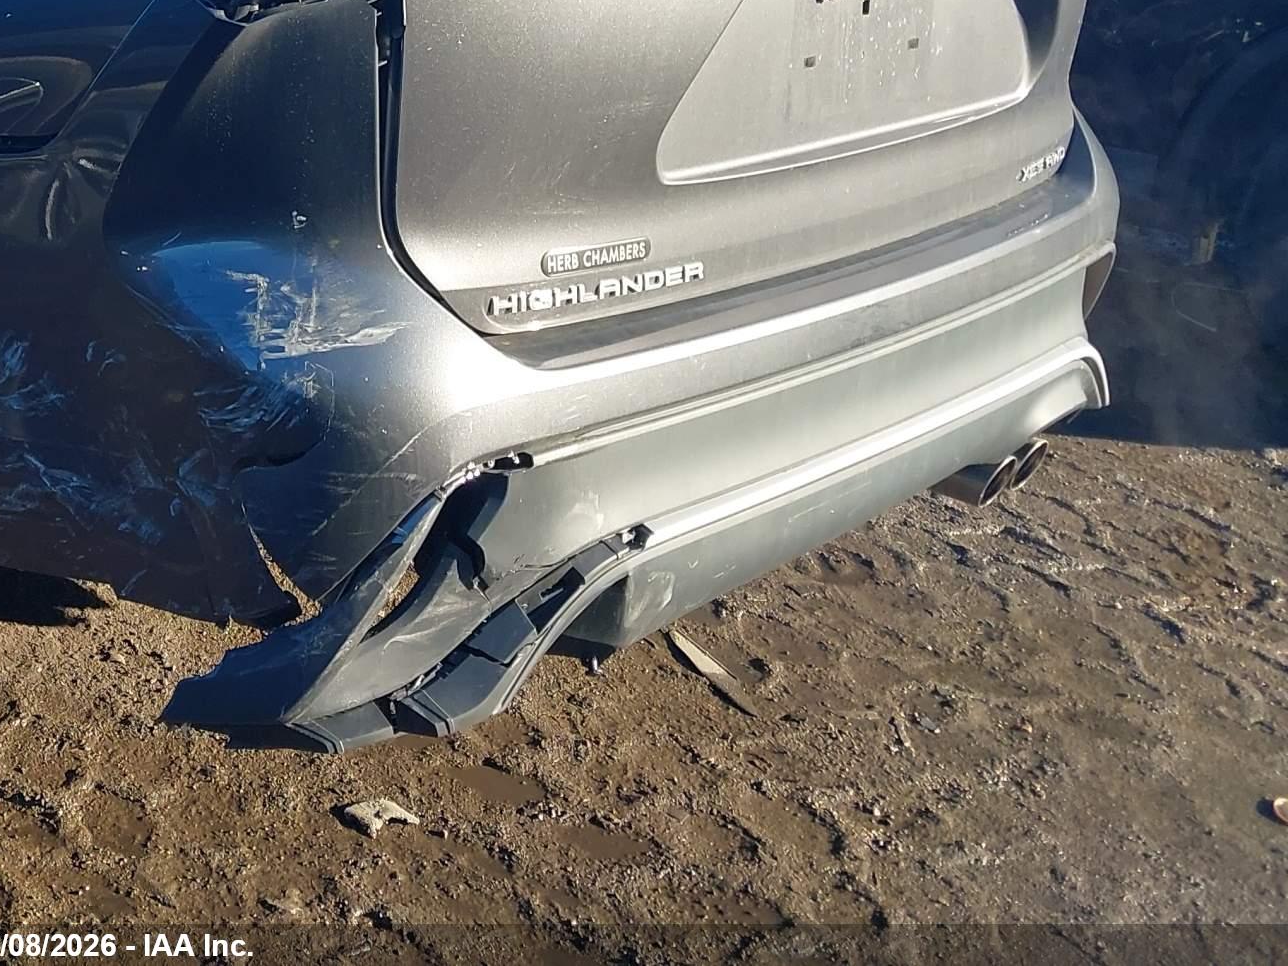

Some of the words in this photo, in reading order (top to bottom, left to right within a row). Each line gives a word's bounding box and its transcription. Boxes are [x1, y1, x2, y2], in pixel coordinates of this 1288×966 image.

[546, 250, 579, 274] HERB
[582, 241, 646, 268] CHAMBERS
[490, 261, 705, 316] HIGHLANDER
